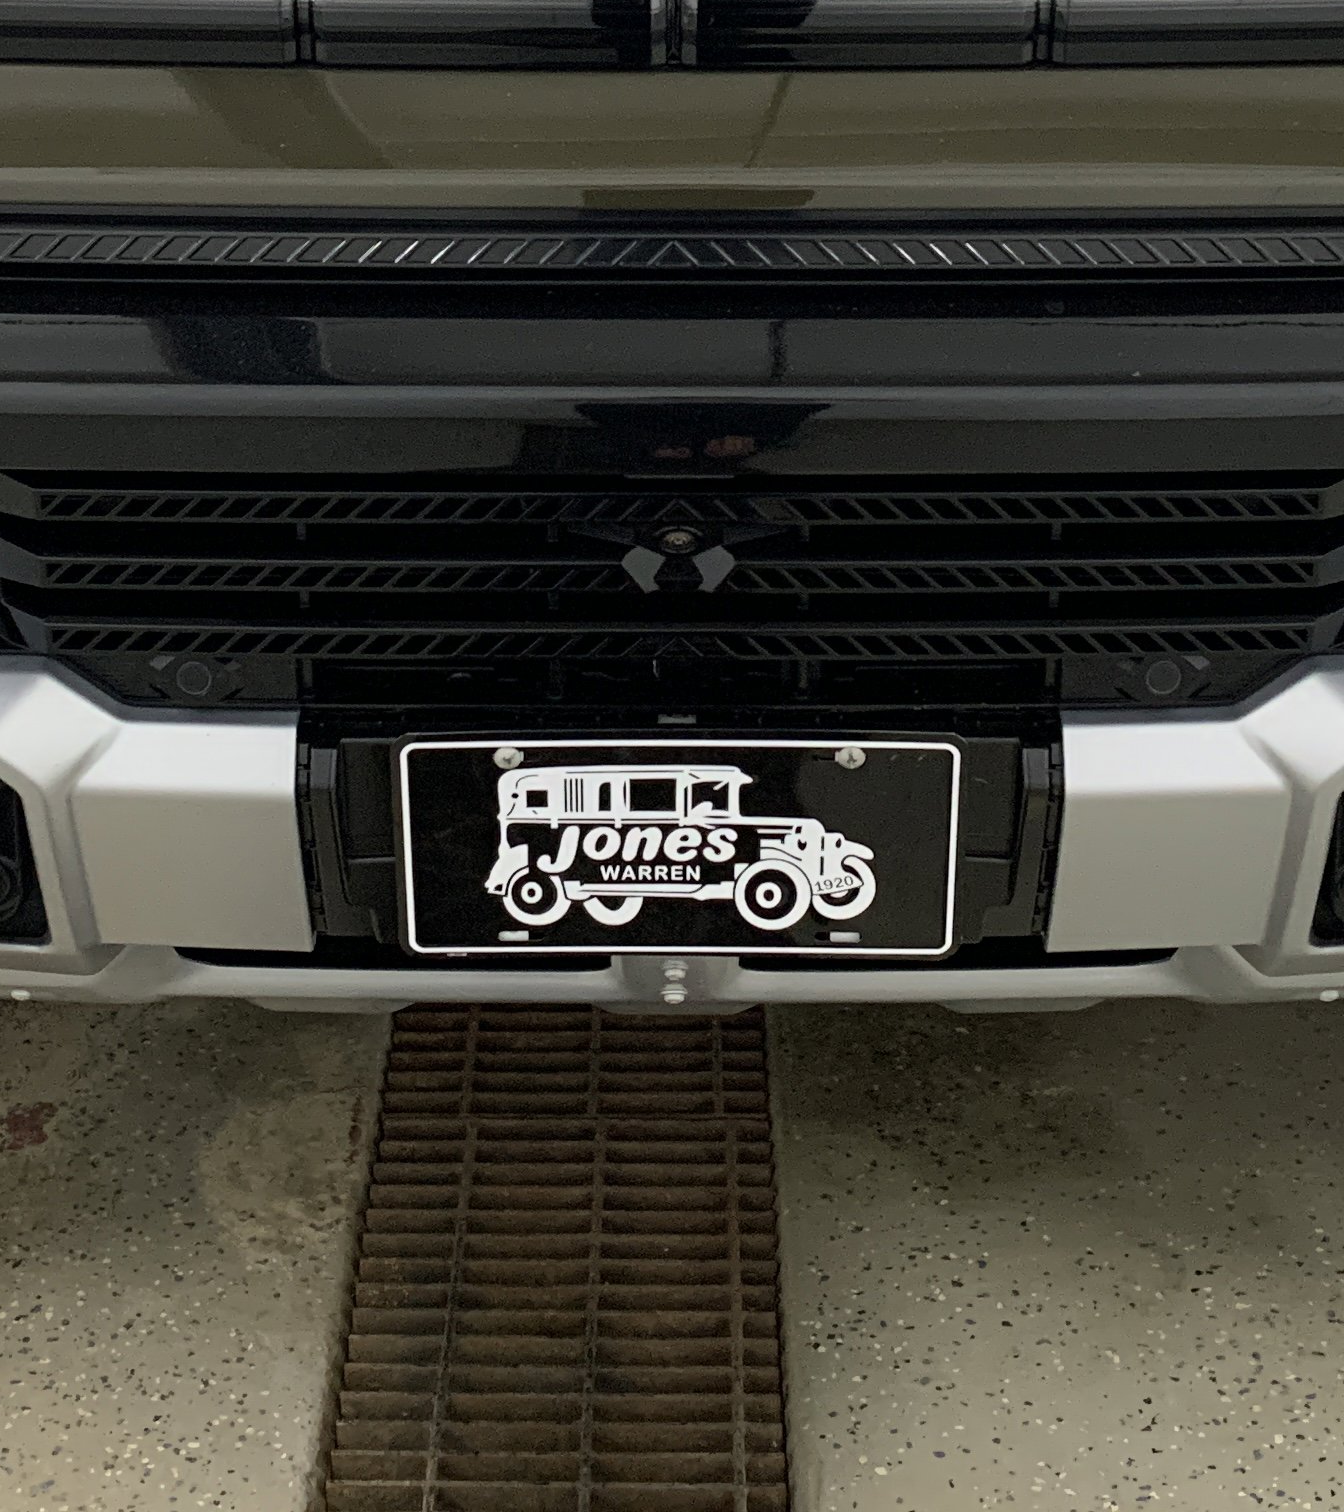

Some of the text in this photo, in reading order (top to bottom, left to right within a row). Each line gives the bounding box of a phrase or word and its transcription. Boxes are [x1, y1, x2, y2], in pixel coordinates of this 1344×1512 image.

[536, 825, 739, 874] Jones
[599, 864, 702, 882] WARREN
[814, 875, 854, 892] 1920
